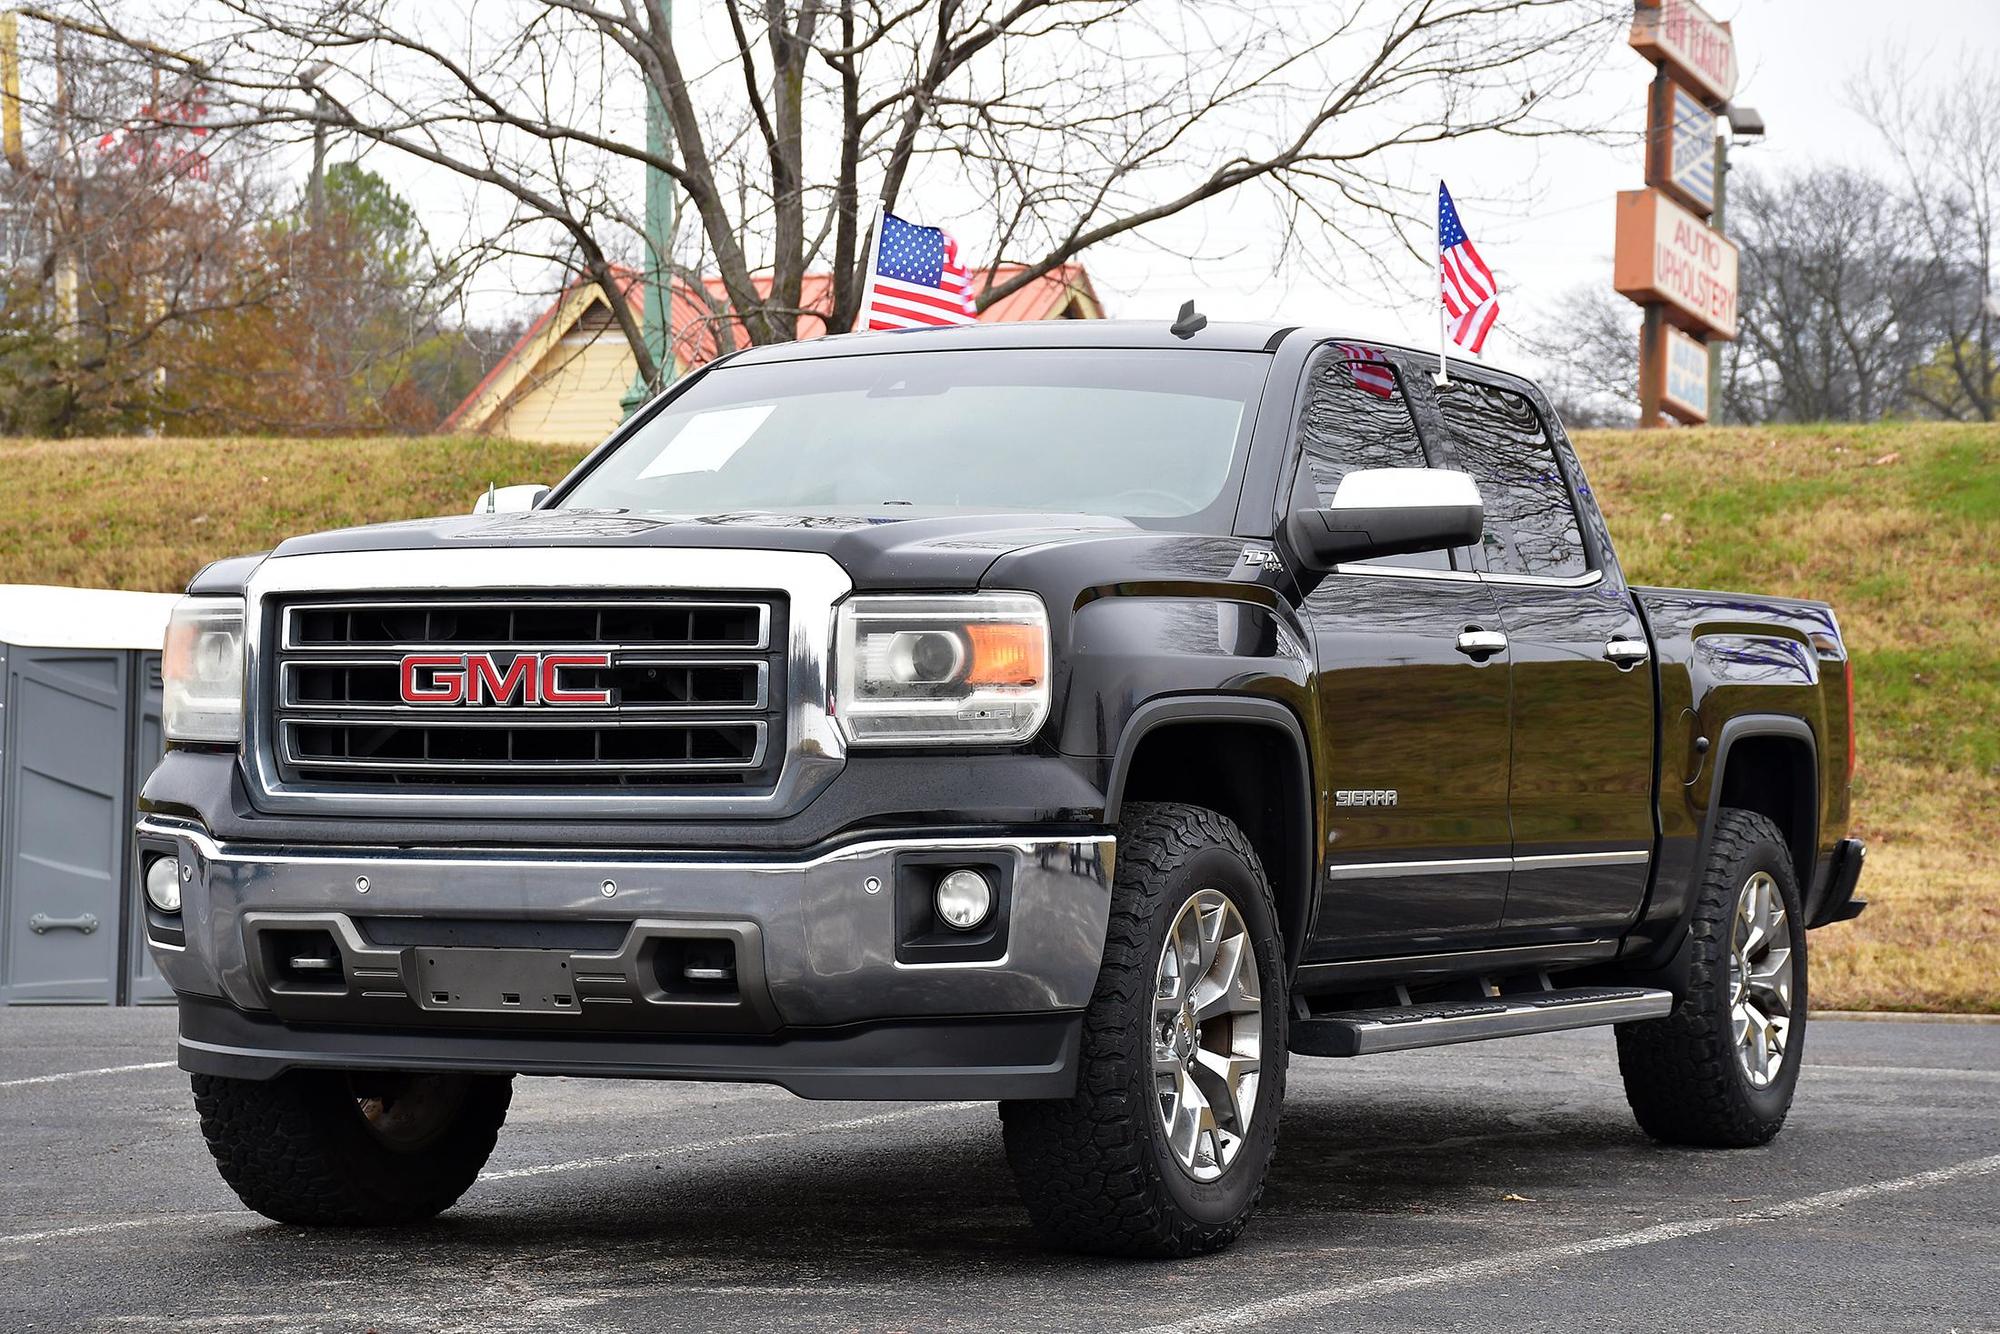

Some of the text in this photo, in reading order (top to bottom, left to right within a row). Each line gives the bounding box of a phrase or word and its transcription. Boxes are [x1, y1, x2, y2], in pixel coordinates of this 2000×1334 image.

[1674, 218, 1721, 271] AUTO
[1657, 242, 1737, 324] UPHOLSTERY
[400, 652, 613, 706] GMC
[1333, 789, 1399, 807] SIERRA
